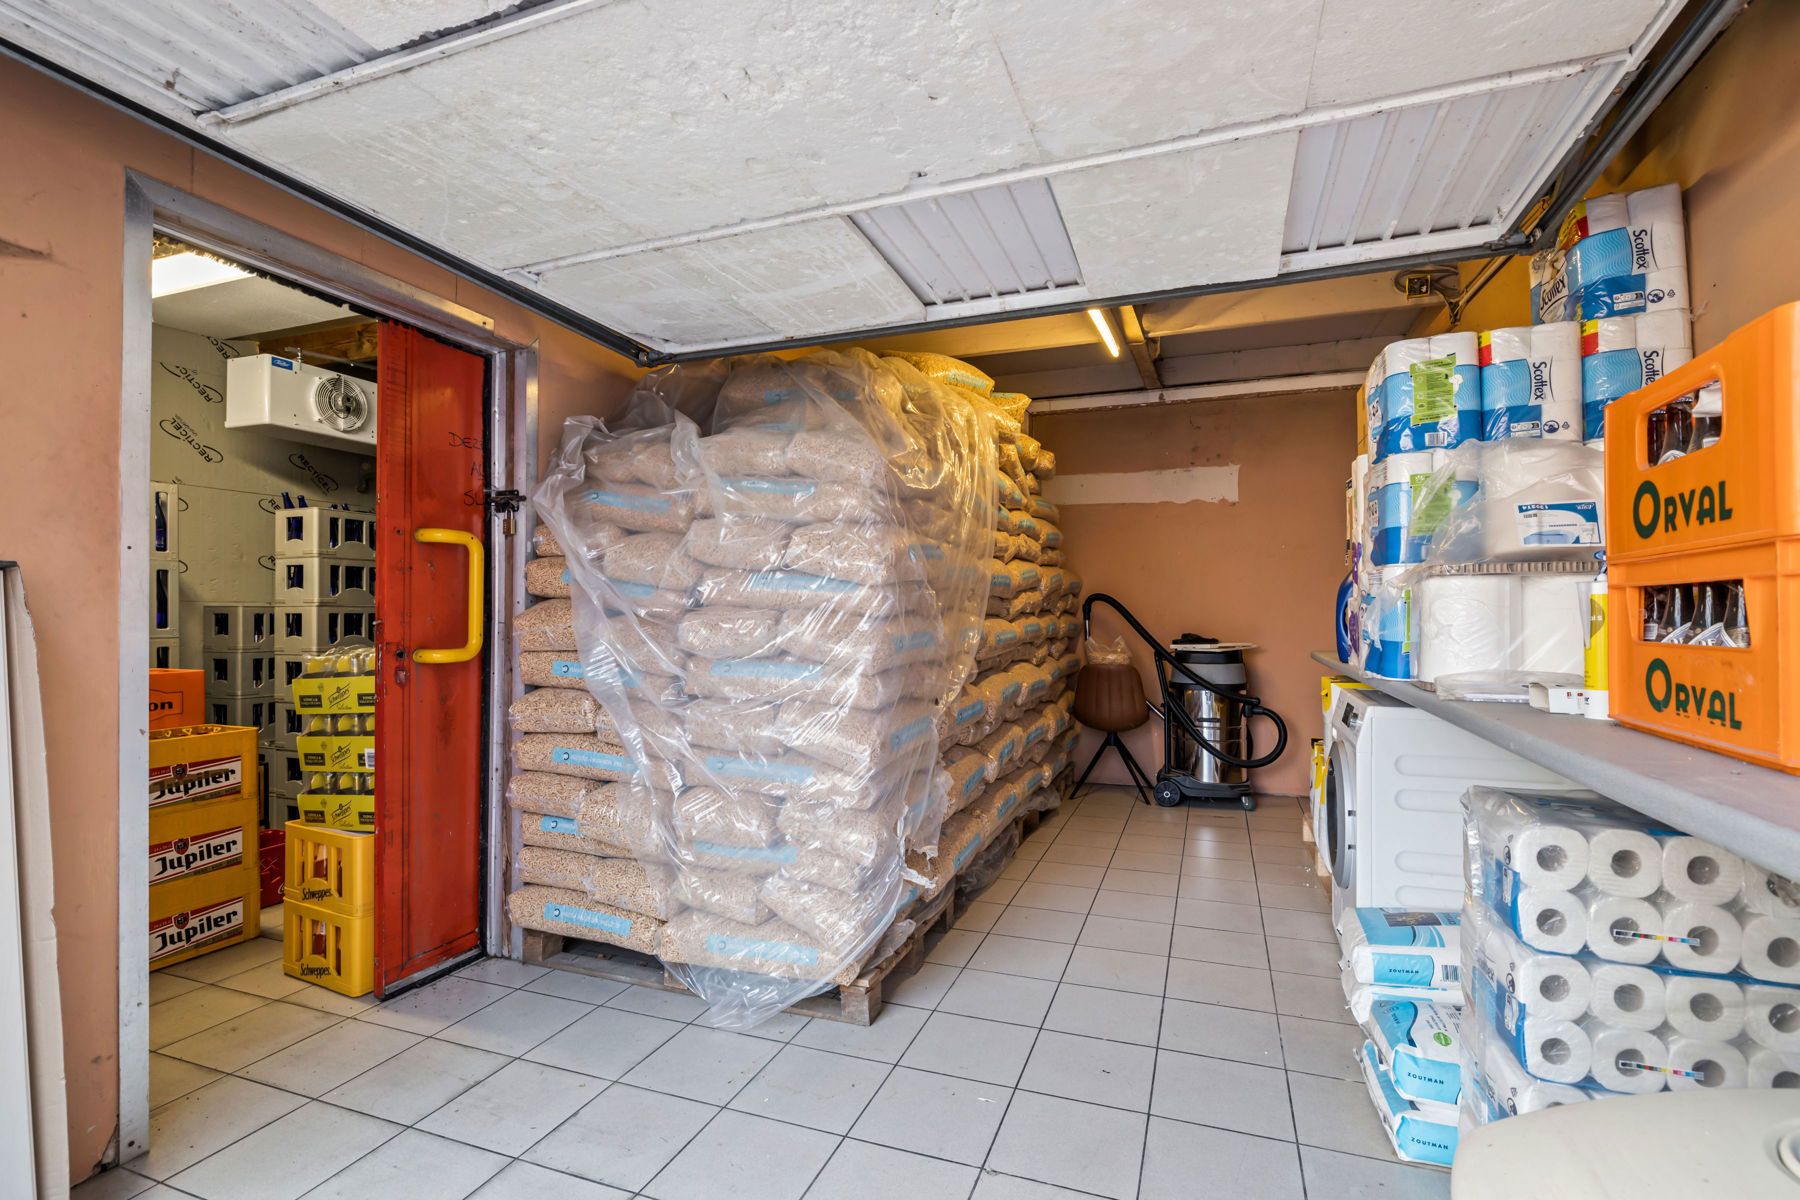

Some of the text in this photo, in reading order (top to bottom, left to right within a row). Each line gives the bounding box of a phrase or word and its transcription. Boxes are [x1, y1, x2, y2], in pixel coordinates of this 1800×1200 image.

[1633, 229, 1648, 270] Scottex
[1533, 361, 1548, 401] Scottex
[1644, 351, 1660, 386] Scotte
[152, 768, 236, 801] Jupiler
[155, 838, 238, 877] Jupiler
[302, 887, 333, 901] Schweppes
[155, 910, 238, 953] Jupiler
[300, 963, 331, 979] Schweppes
[1407, 1072, 1445, 1086] ZOUTMAN
[1411, 1136, 1449, 1150] ZOUTMAN
